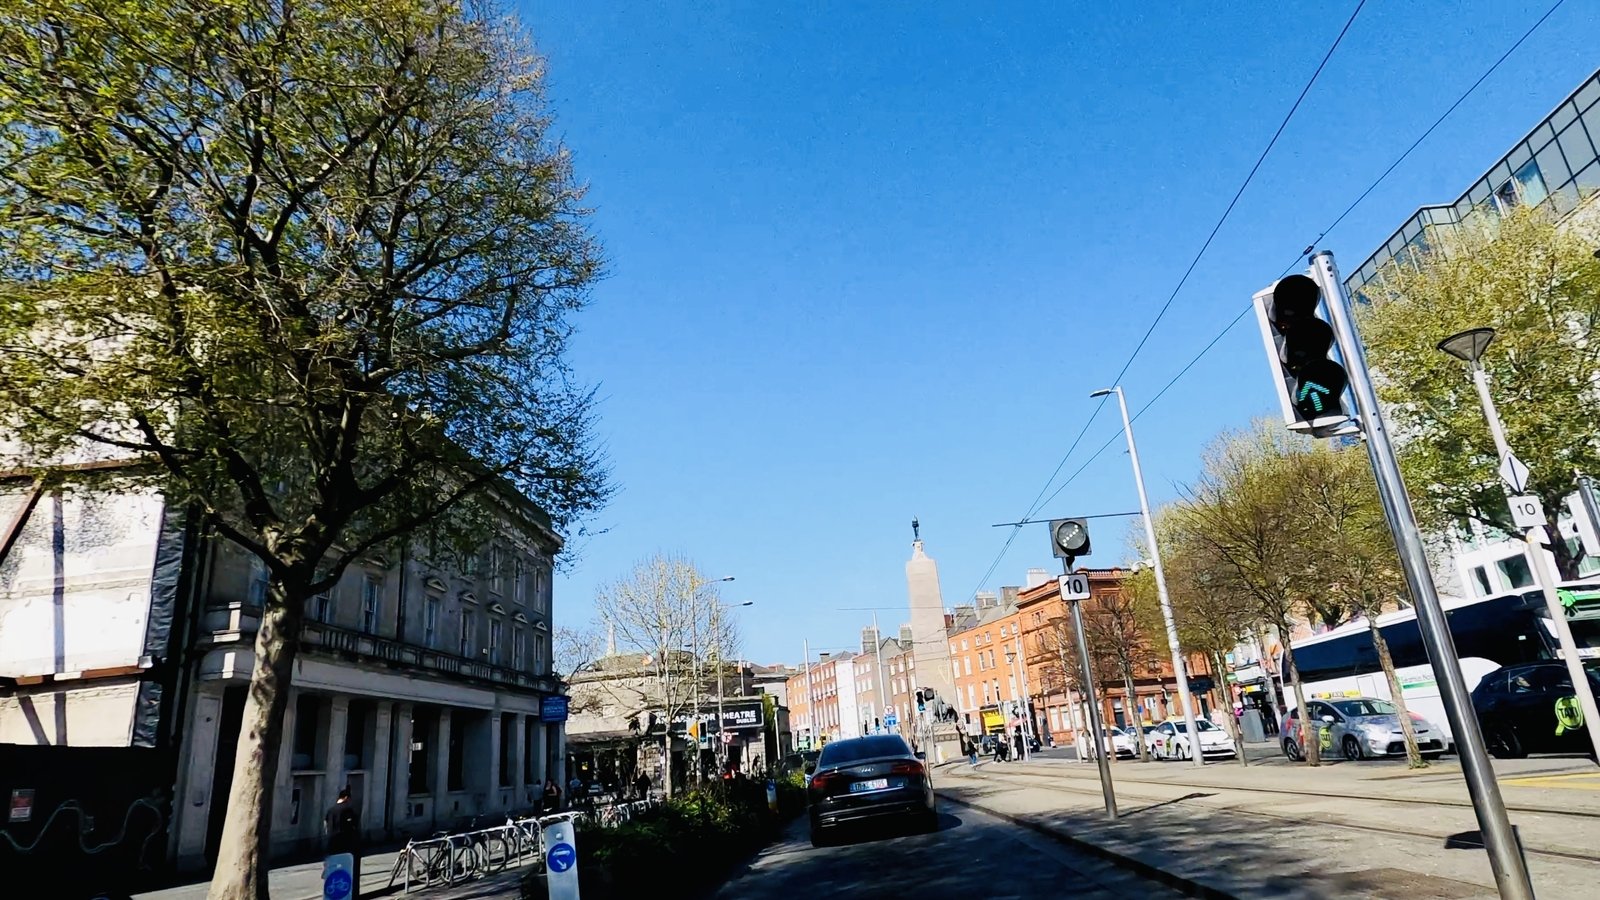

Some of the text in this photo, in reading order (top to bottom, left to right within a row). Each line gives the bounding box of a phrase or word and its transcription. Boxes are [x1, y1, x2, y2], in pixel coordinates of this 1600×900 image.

[1517, 503, 1536, 516] 10
[1064, 579, 1083, 595] 10
[1557, 706, 1579, 718] TAXI
